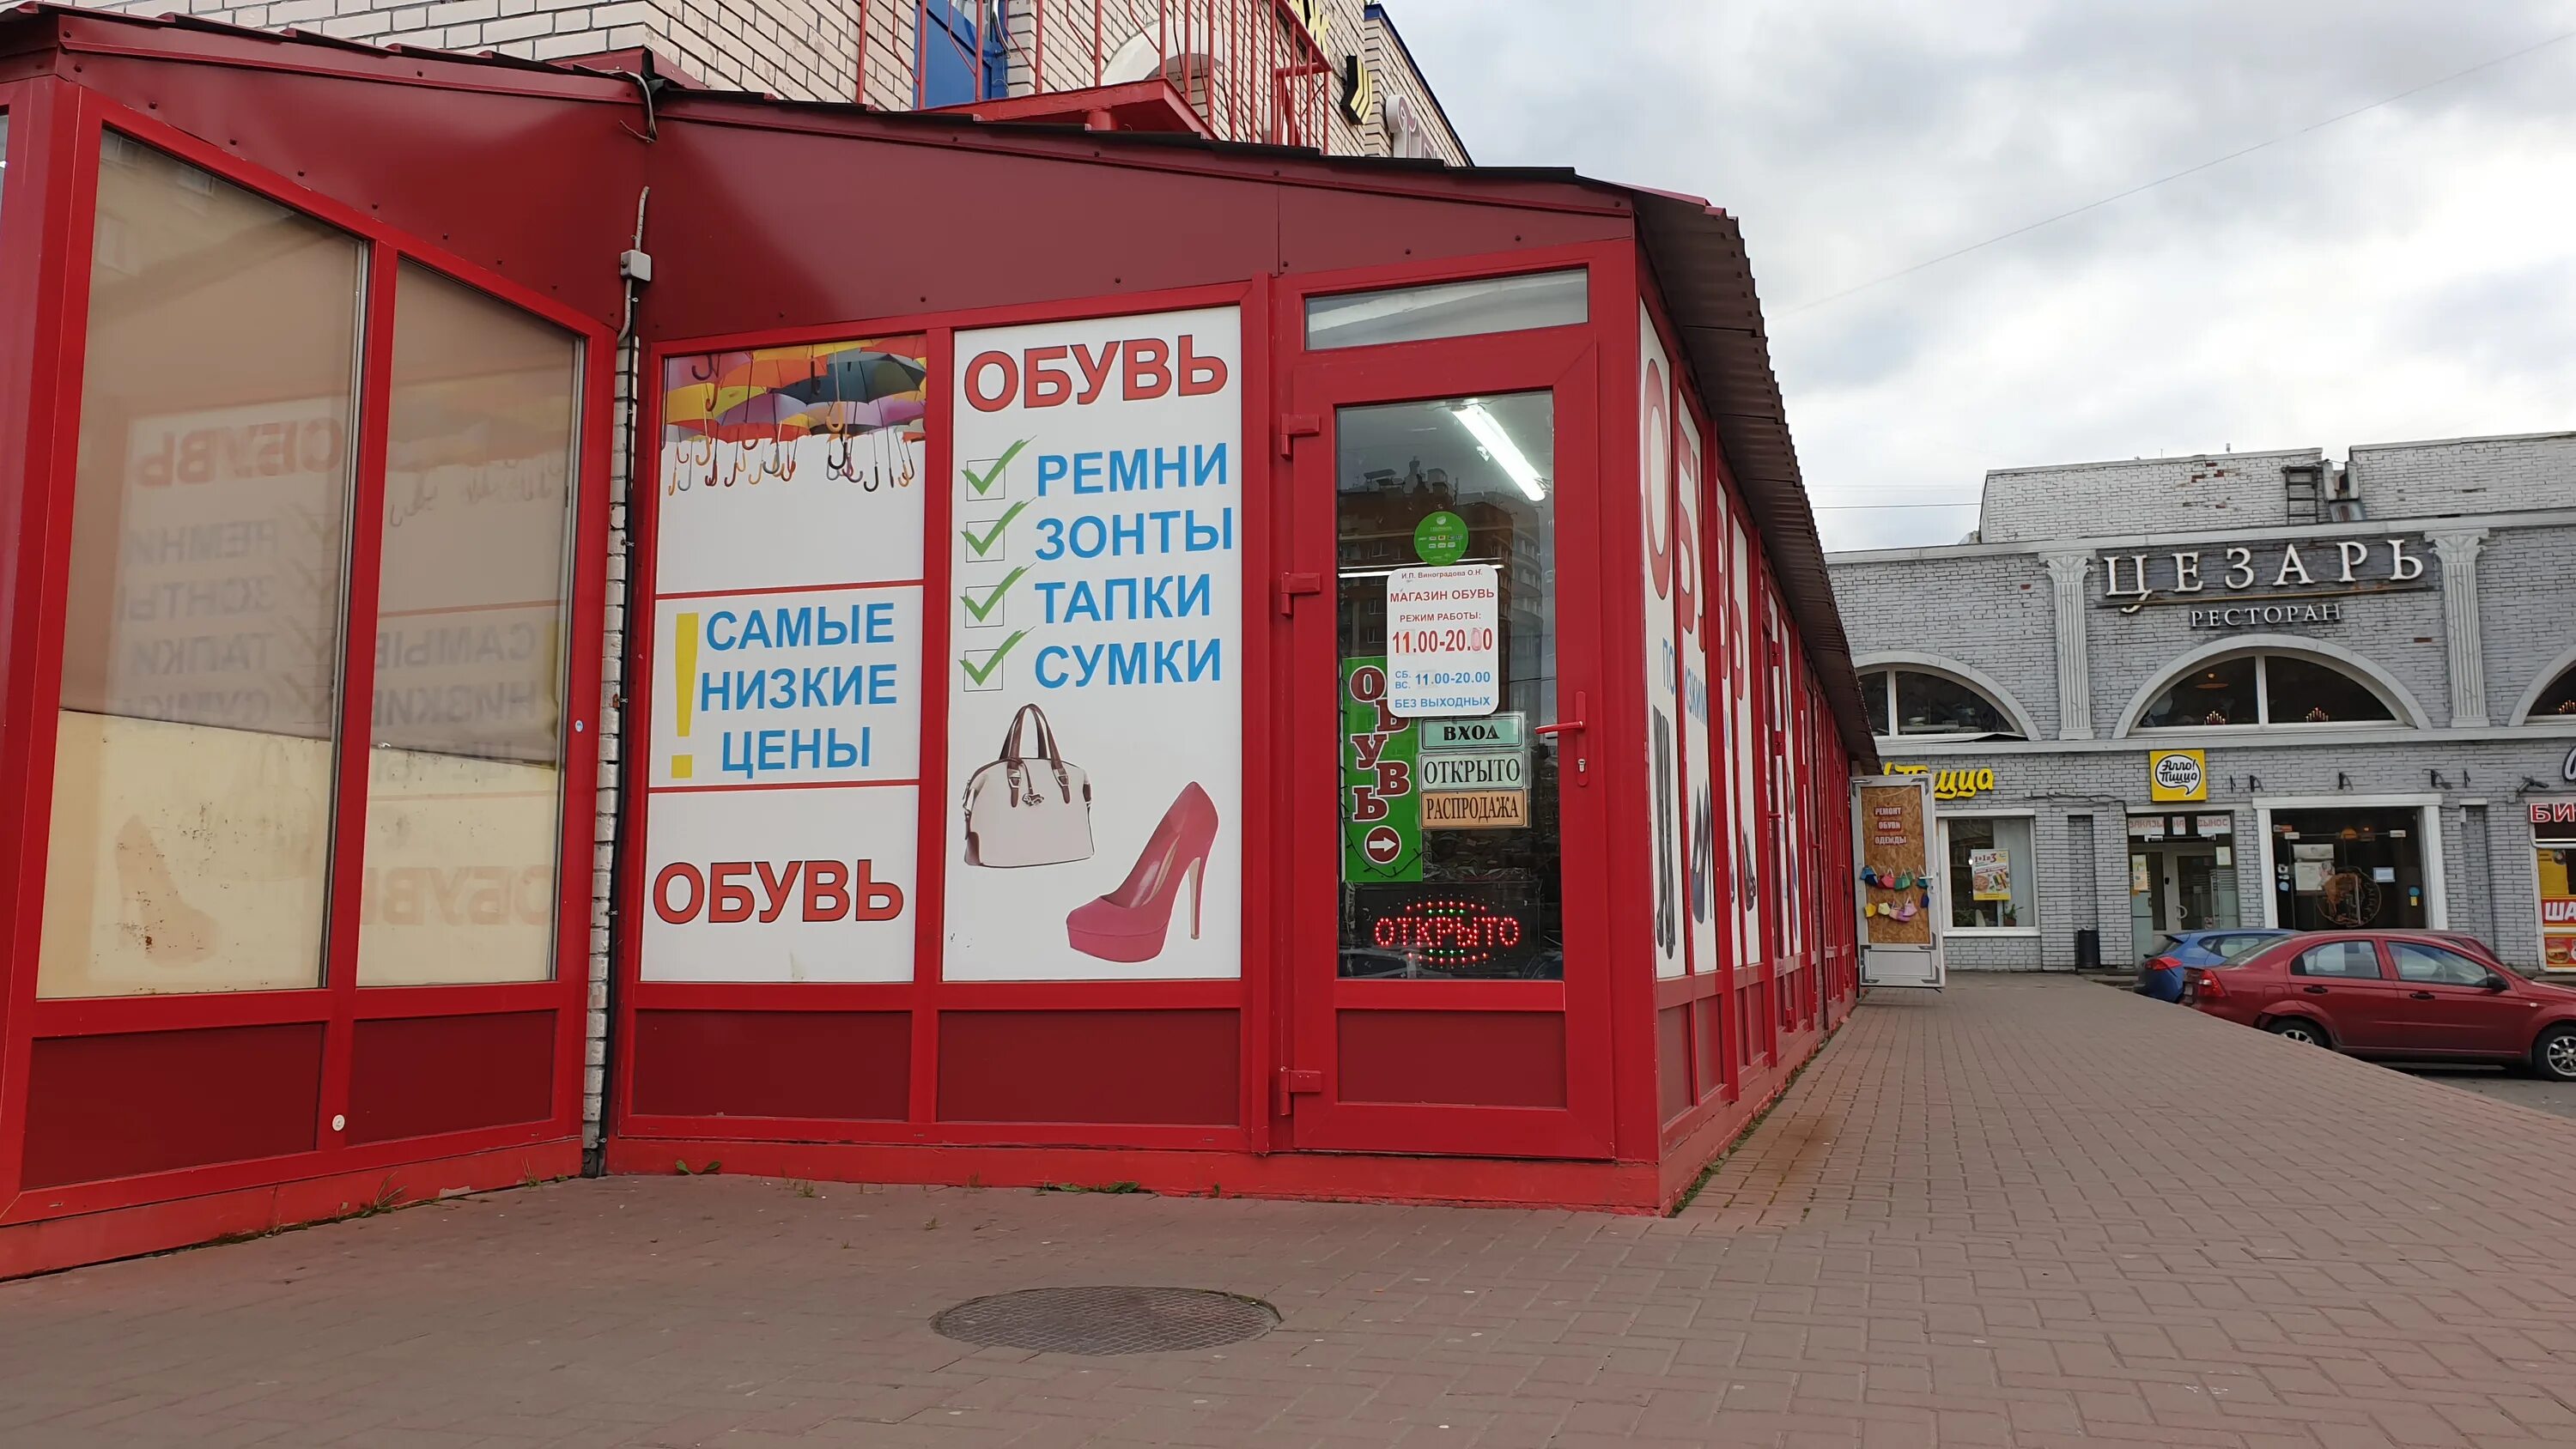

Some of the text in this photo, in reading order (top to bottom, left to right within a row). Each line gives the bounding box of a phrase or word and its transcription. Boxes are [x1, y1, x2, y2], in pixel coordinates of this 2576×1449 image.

[964, 334, 1229, 413] ОБУВЬ
[1037, 442, 1228, 497] РЕМНИ
[1035, 506, 1232, 561] ЗОНТЫ
[1418, 570, 1466, 579] Виноградова
[2104, 538, 2424, 614] ЦЕЗАРЬ
[1035, 573, 1211, 624] ТАПКИ
[1390, 588, 1495, 603] МАГАЗИН ОБУВЬ
[1400, 612, 1481, 623] РЕЖИМ РАБОТЫ:
[2190, 603, 2342, 627] РЕСТОРАН
[706, 603, 895, 652] САМЫЕ
[1035, 638, 1221, 688] СУМКИ
[1395, 670, 1411, 679] СБ.
[701, 664, 897, 712] НИЗКИЕ
[1395, 681, 1411, 689] ВС.
[1415, 671, 1491, 686] 11.00-20.00
[1394, 697, 1491, 708] БЕЗ ВЫХОДНЫХ
[1443, 724, 1500, 741] ВХОД
[722, 726, 870, 779] ЦЕНЫ
[1424, 758, 1521, 785] ОТКРЫТО
[2161, 759, 2196, 771] Алло!
[2159, 771, 2198, 784] Пицца
[1425, 795, 1519, 823] РАСПРОДАЖА
[1874, 807, 1902, 815] РЕМОНТ
[2129, 818, 2228, 829] ЗАКАЗЫ НА ВЫНОС
[1874, 835, 1907, 846] ОДЕЖДЫ
[653, 858, 904, 925] ОБУВЬ
[1375, 916, 1520, 947] ОТКРЫТО
